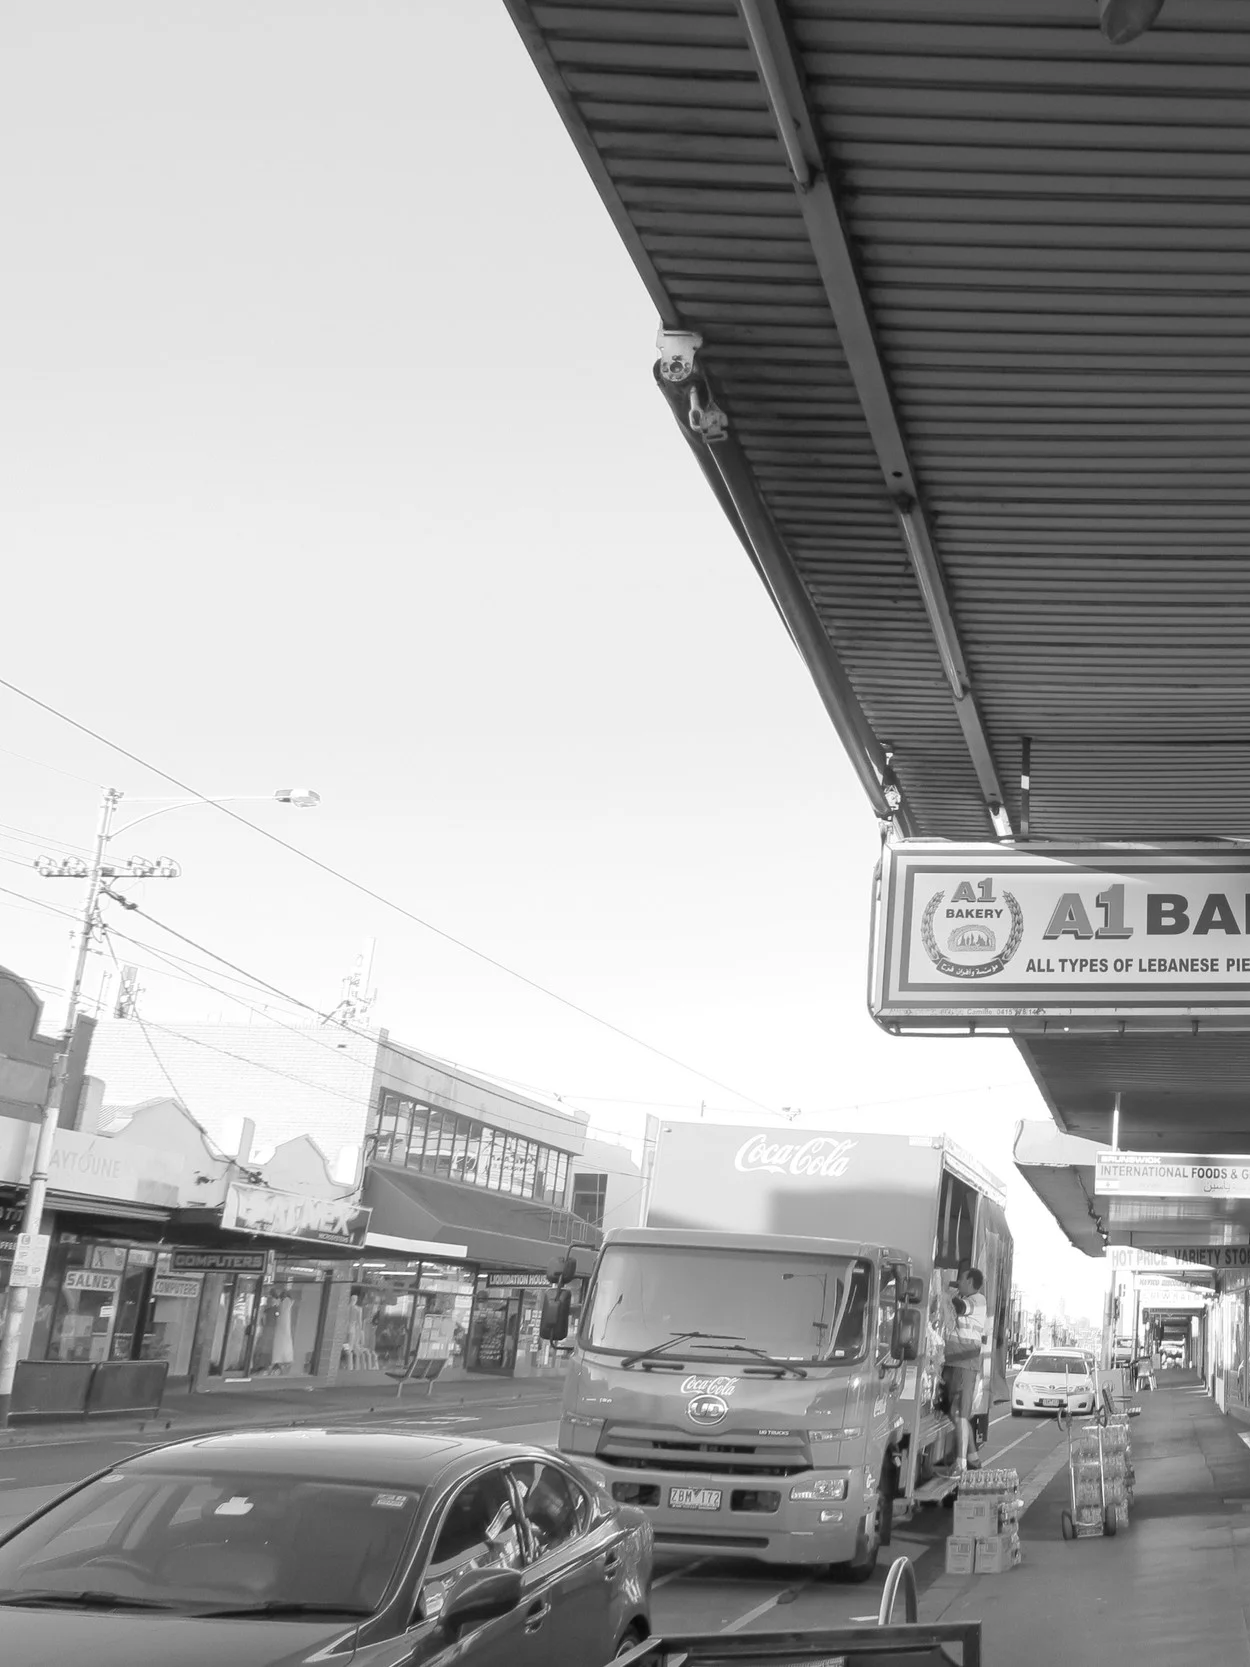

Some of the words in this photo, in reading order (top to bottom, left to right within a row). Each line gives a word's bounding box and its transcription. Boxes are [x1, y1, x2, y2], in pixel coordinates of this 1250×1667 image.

[950, 877, 997, 903] A1
[945, 908, 1004, 919] BAKERY
[1042, 883, 1134, 940] A1
[1025, 958, 1055, 973] ALL
[1058, 958, 1109, 973] TYPES
[1113, 958, 1134, 973] OF
[1138, 958, 1220, 973] LEBANESE
[1100, 1165, 1189, 1179] INTERNATIONAL
[1191, 1167, 1228, 1179] FOODS
[1230, 1168, 1238, 1179] &
[174, 1253, 263, 1268] COMPUTERS
[1112, 1250, 1132, 1267] HOT
[1136, 1249, 1168, 1266] PRICE
[1174, 1249, 1222, 1265] VARIETY
[66, 1270, 118, 1290] SALNEX
[489, 1274, 529, 1285] LIQUIDATION
[529, 1274, 550, 1285] HOUS
